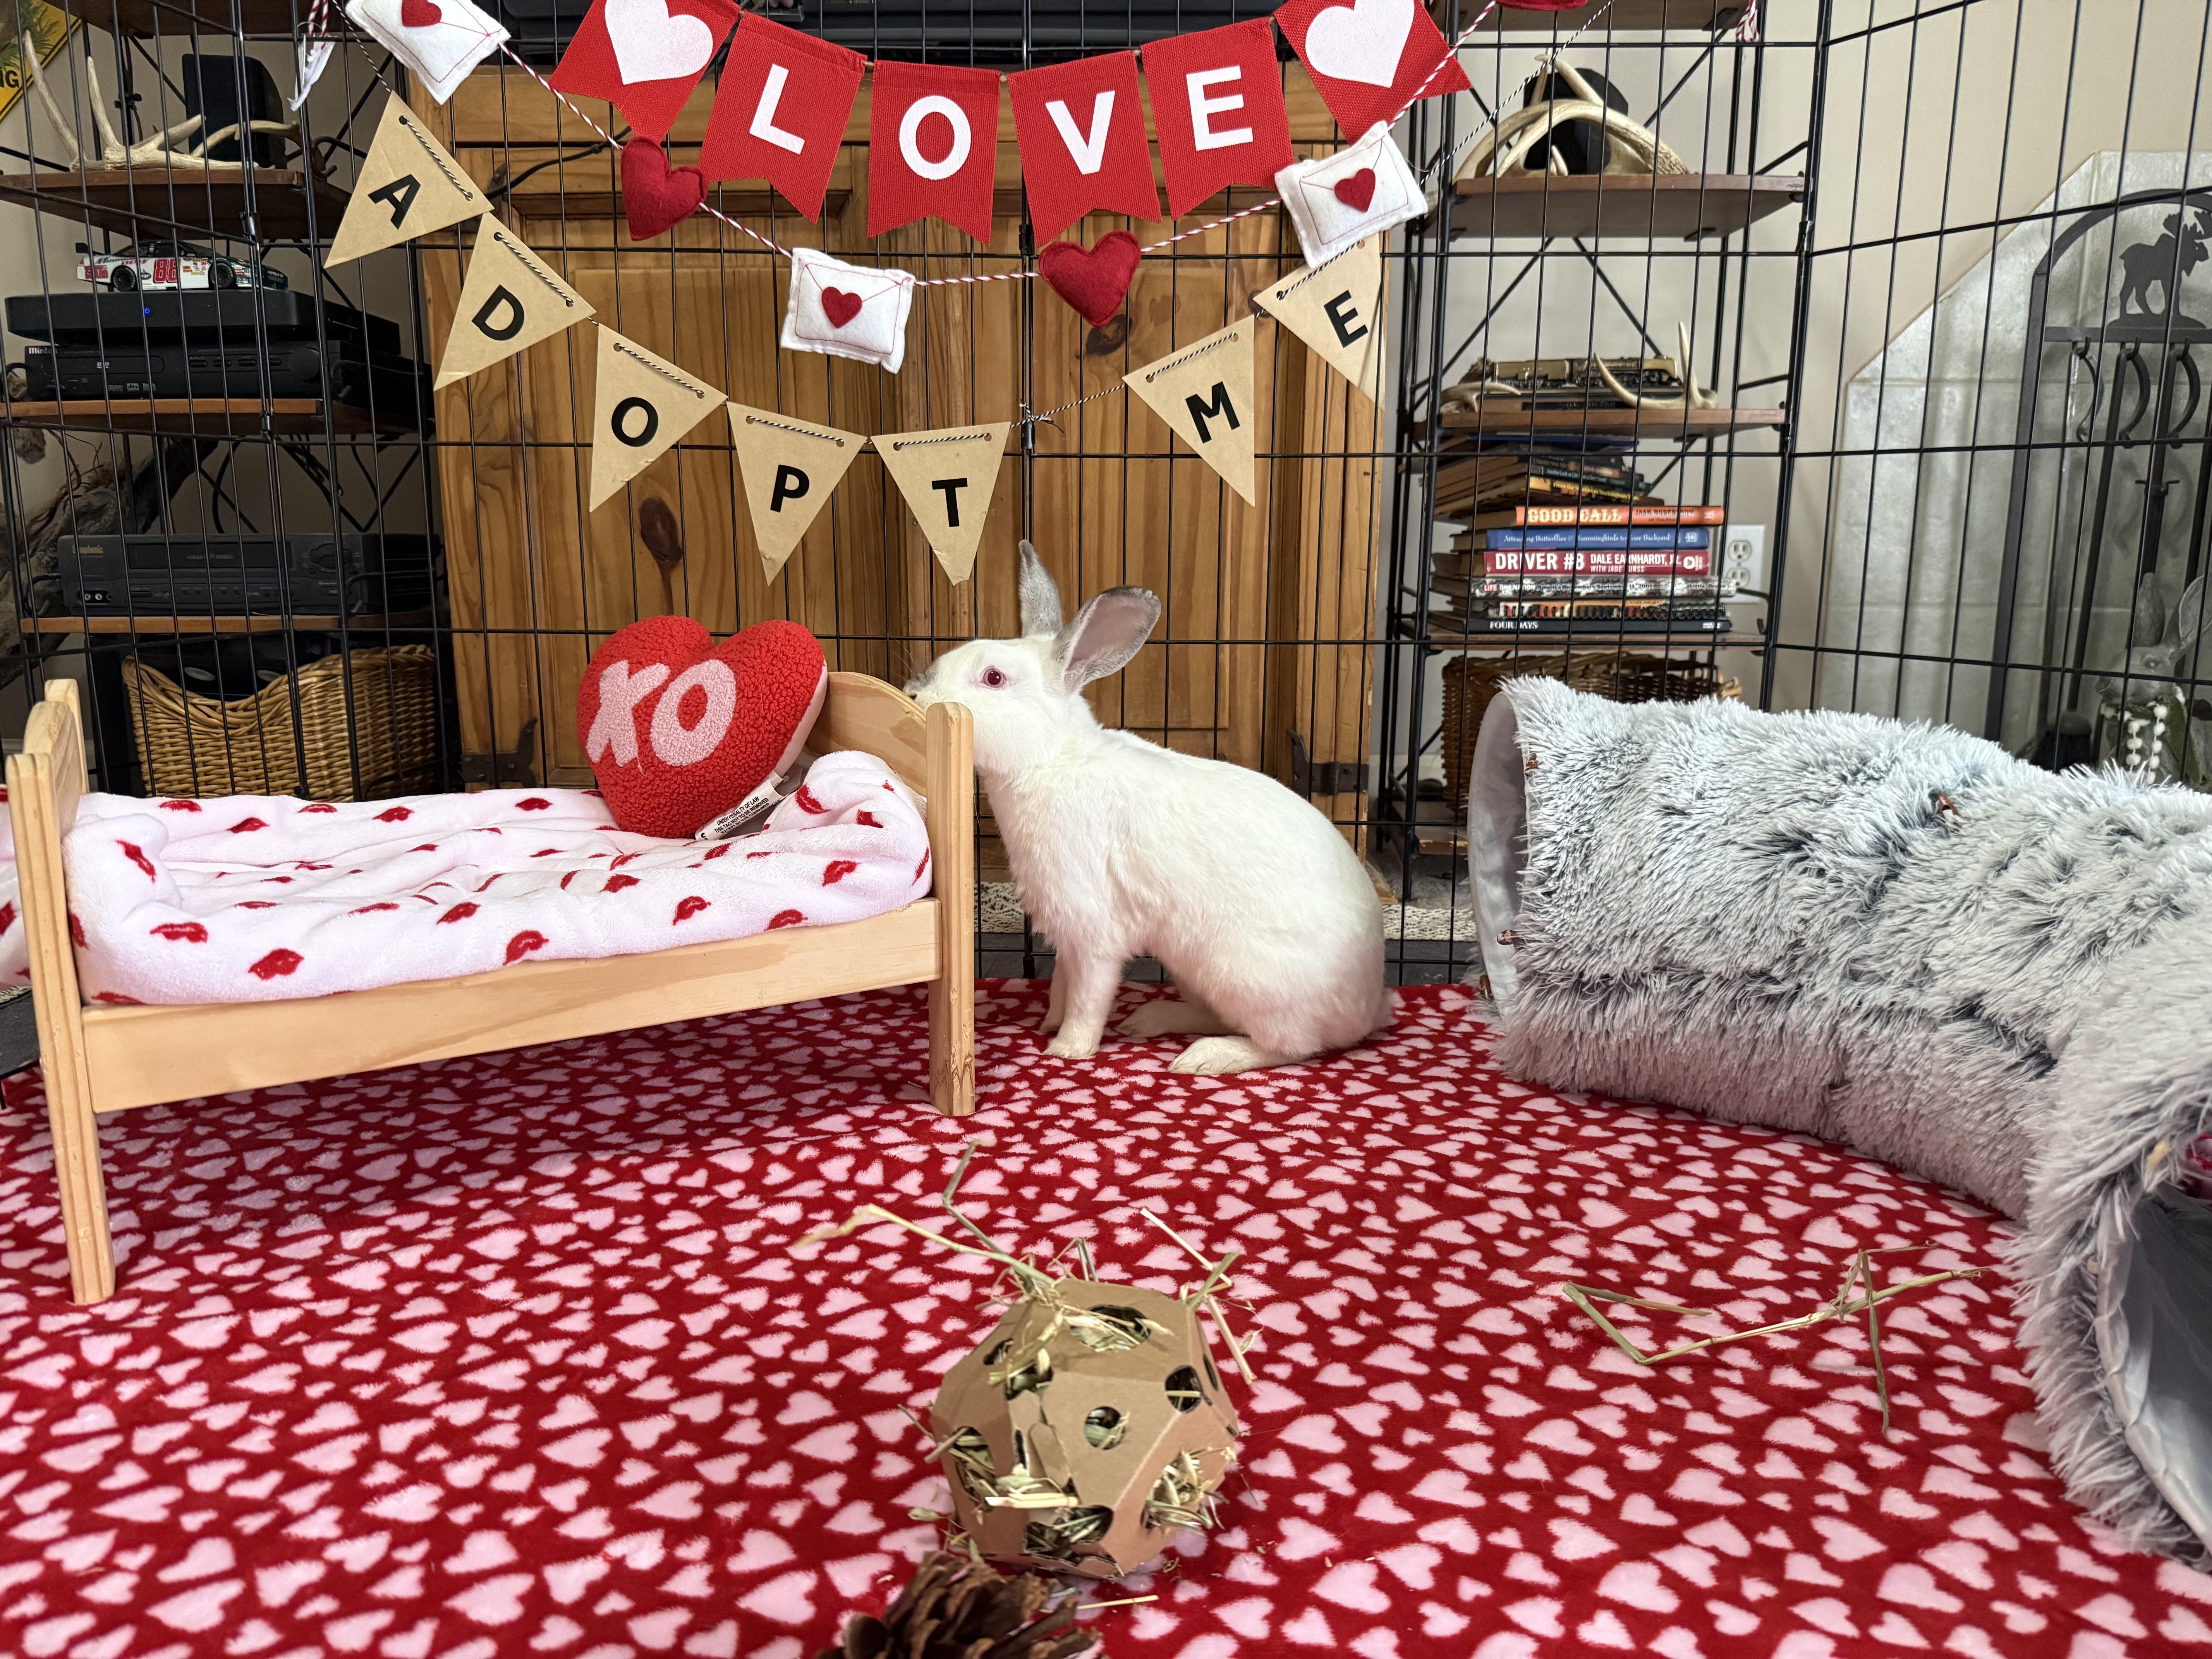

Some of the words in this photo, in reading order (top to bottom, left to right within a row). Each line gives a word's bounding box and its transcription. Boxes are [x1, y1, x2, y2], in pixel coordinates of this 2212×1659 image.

[749, 64, 1254, 180] LOVE
[153, 259, 181, 283] 88
[368, 174, 968, 527] ADOPT
[1185, 290, 1368, 444] ME
[1527, 508, 1573, 523] GOOD
[1580, 508, 1622, 523] CALL
[1504, 535, 1534, 543] Attracng
[1535, 533, 1566, 542] Butterflies
[1578, 533, 1618, 542] ummingbirds
[1643, 533, 1670, 542] Backyard
[1495, 553, 1557, 570] DRIVER
[1564, 553, 1585, 570] #8
[1590, 553, 1611, 565] DALE
[1628, 565, 1645, 573] URSS
[1490, 621, 1514, 629] FOUR
[1515, 621, 1539, 629] DAYS
[586, 659, 736, 767] XO
[716, 816, 729, 826] UNDER
[729, 805, 745, 819] PENALTY
[750, 795, 760, 805] LAW
[749, 797, 769, 811] REMOVED
